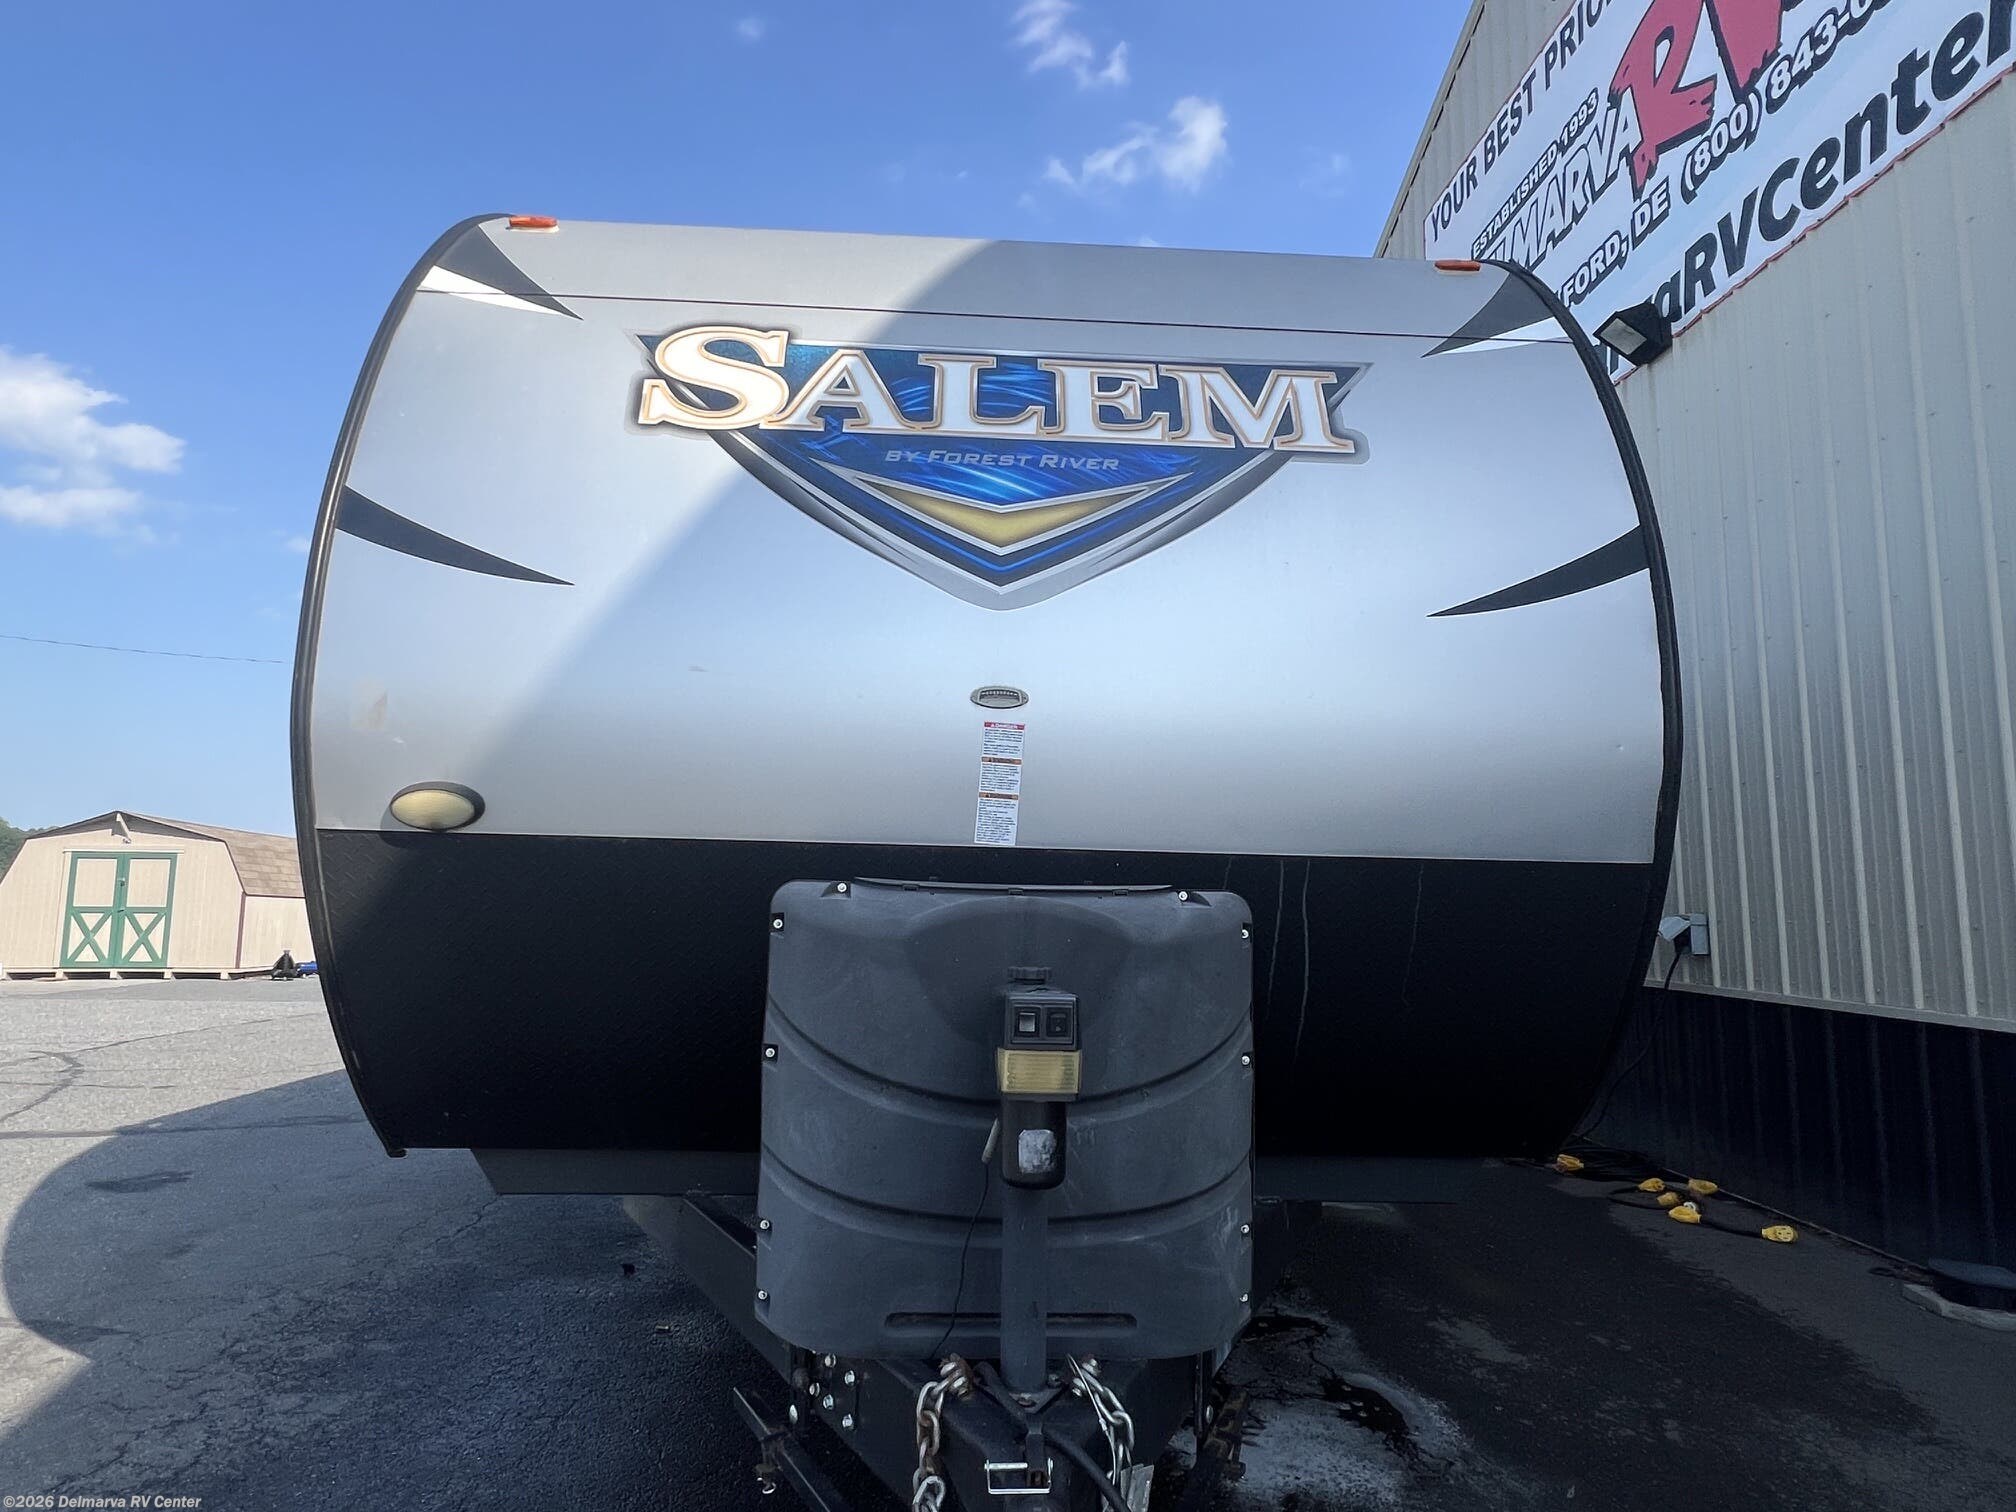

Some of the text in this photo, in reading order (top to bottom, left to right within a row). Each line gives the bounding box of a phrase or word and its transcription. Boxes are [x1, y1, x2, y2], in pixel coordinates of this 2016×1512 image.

[1431, 0, 1612, 243] YOUR BEST PRIC
[1472, 90, 1599, 260] ESTABLISHED 1993
[1556, 231, 1629, 306] FORD,
[1632, 178, 1670, 249] DE
[1682, 88, 1761, 202] (800)
[637, 325, 1356, 454] SALEM
[885, 449, 1120, 471] BY FOREST RIVER
